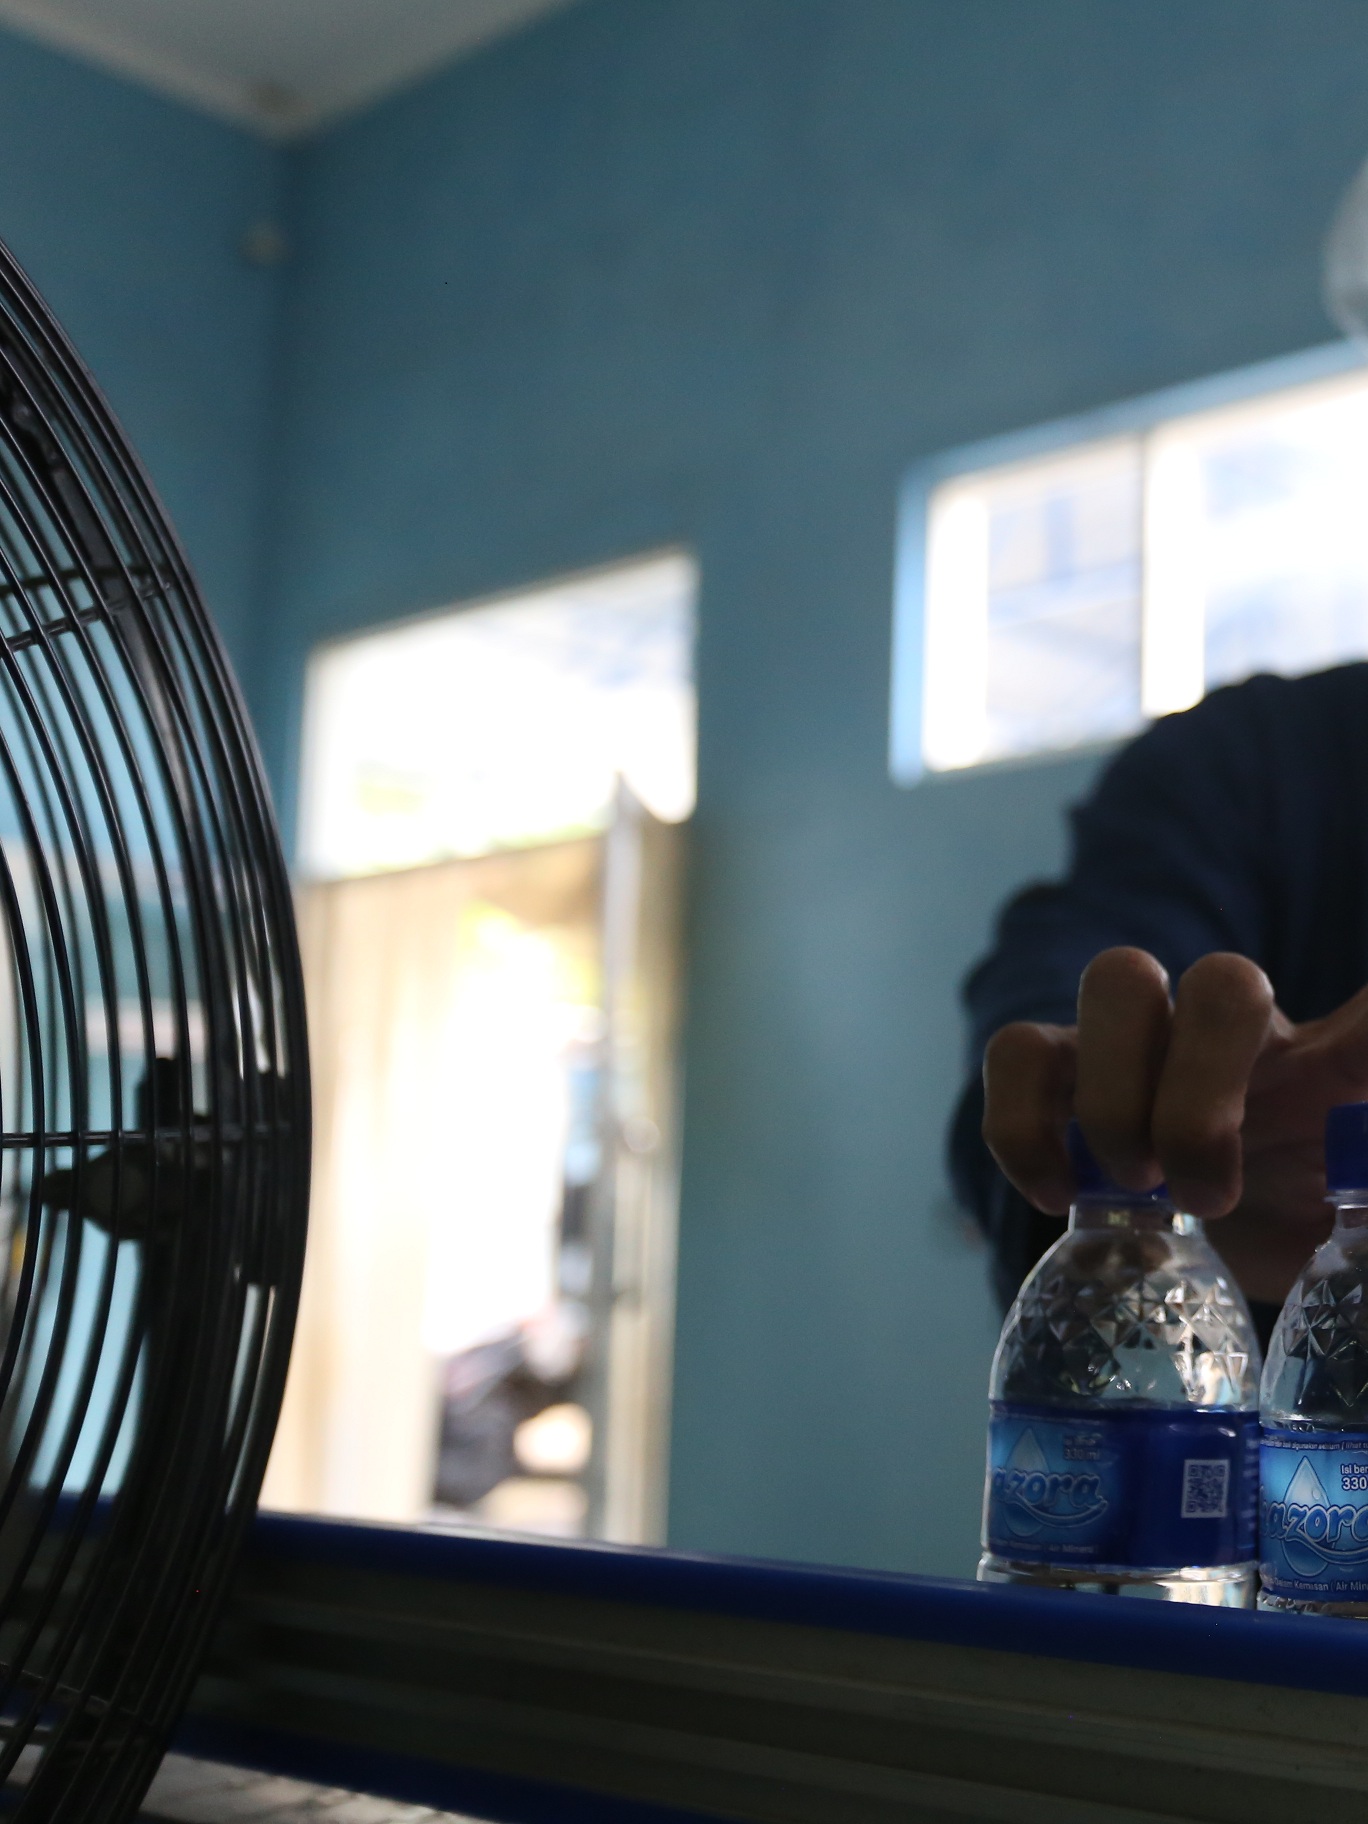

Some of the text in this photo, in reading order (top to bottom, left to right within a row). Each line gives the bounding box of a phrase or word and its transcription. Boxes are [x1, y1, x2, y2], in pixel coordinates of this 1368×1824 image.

[1342, 1476, 1367, 1490] 330
[1294, 1580, 1329, 1591] Kemasan
[1336, 1581, 1348, 1591] Air
